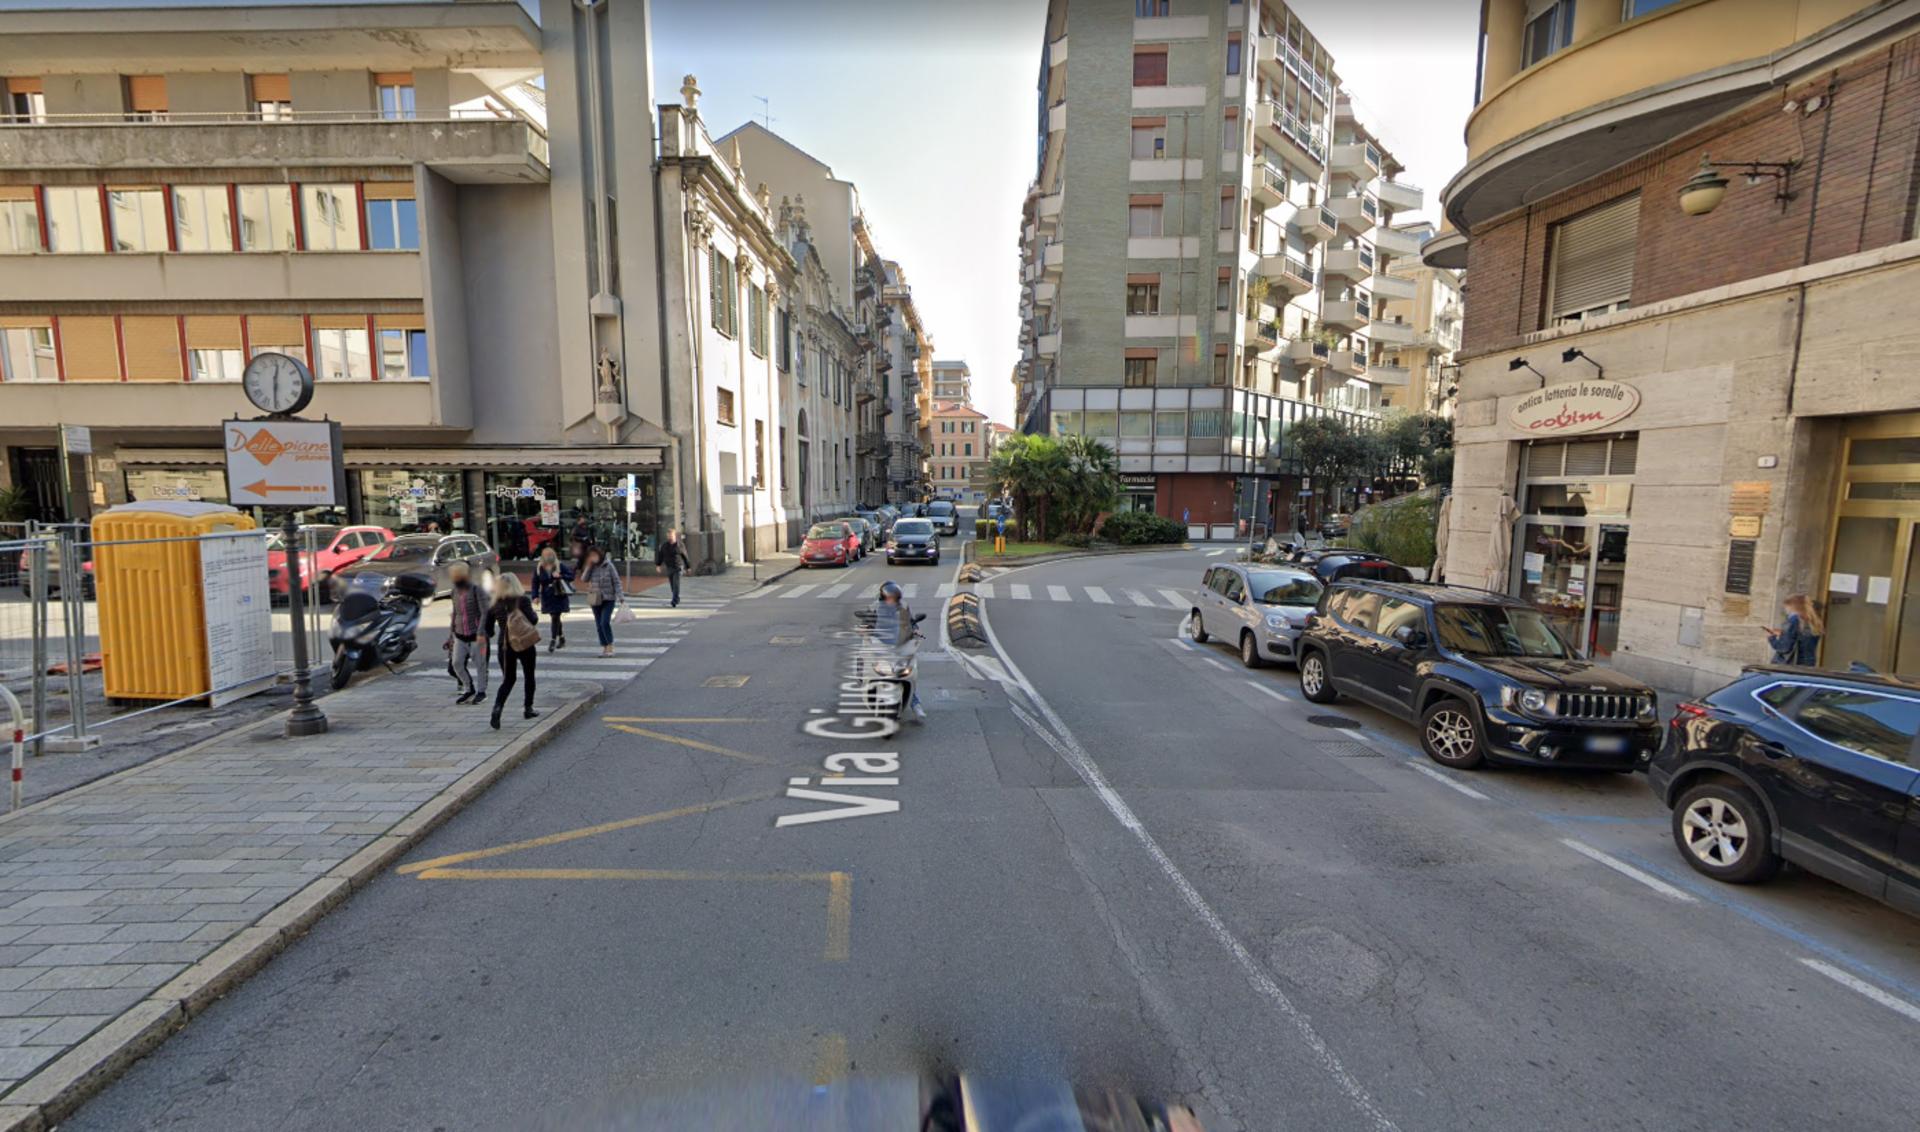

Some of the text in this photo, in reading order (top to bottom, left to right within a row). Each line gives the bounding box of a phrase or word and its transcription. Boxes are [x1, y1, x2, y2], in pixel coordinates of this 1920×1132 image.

[1518, 382, 1625, 413] antica latteria le sorelle
[497, 485, 545, 497] Papeete
[593, 485, 641, 498] Papeee
